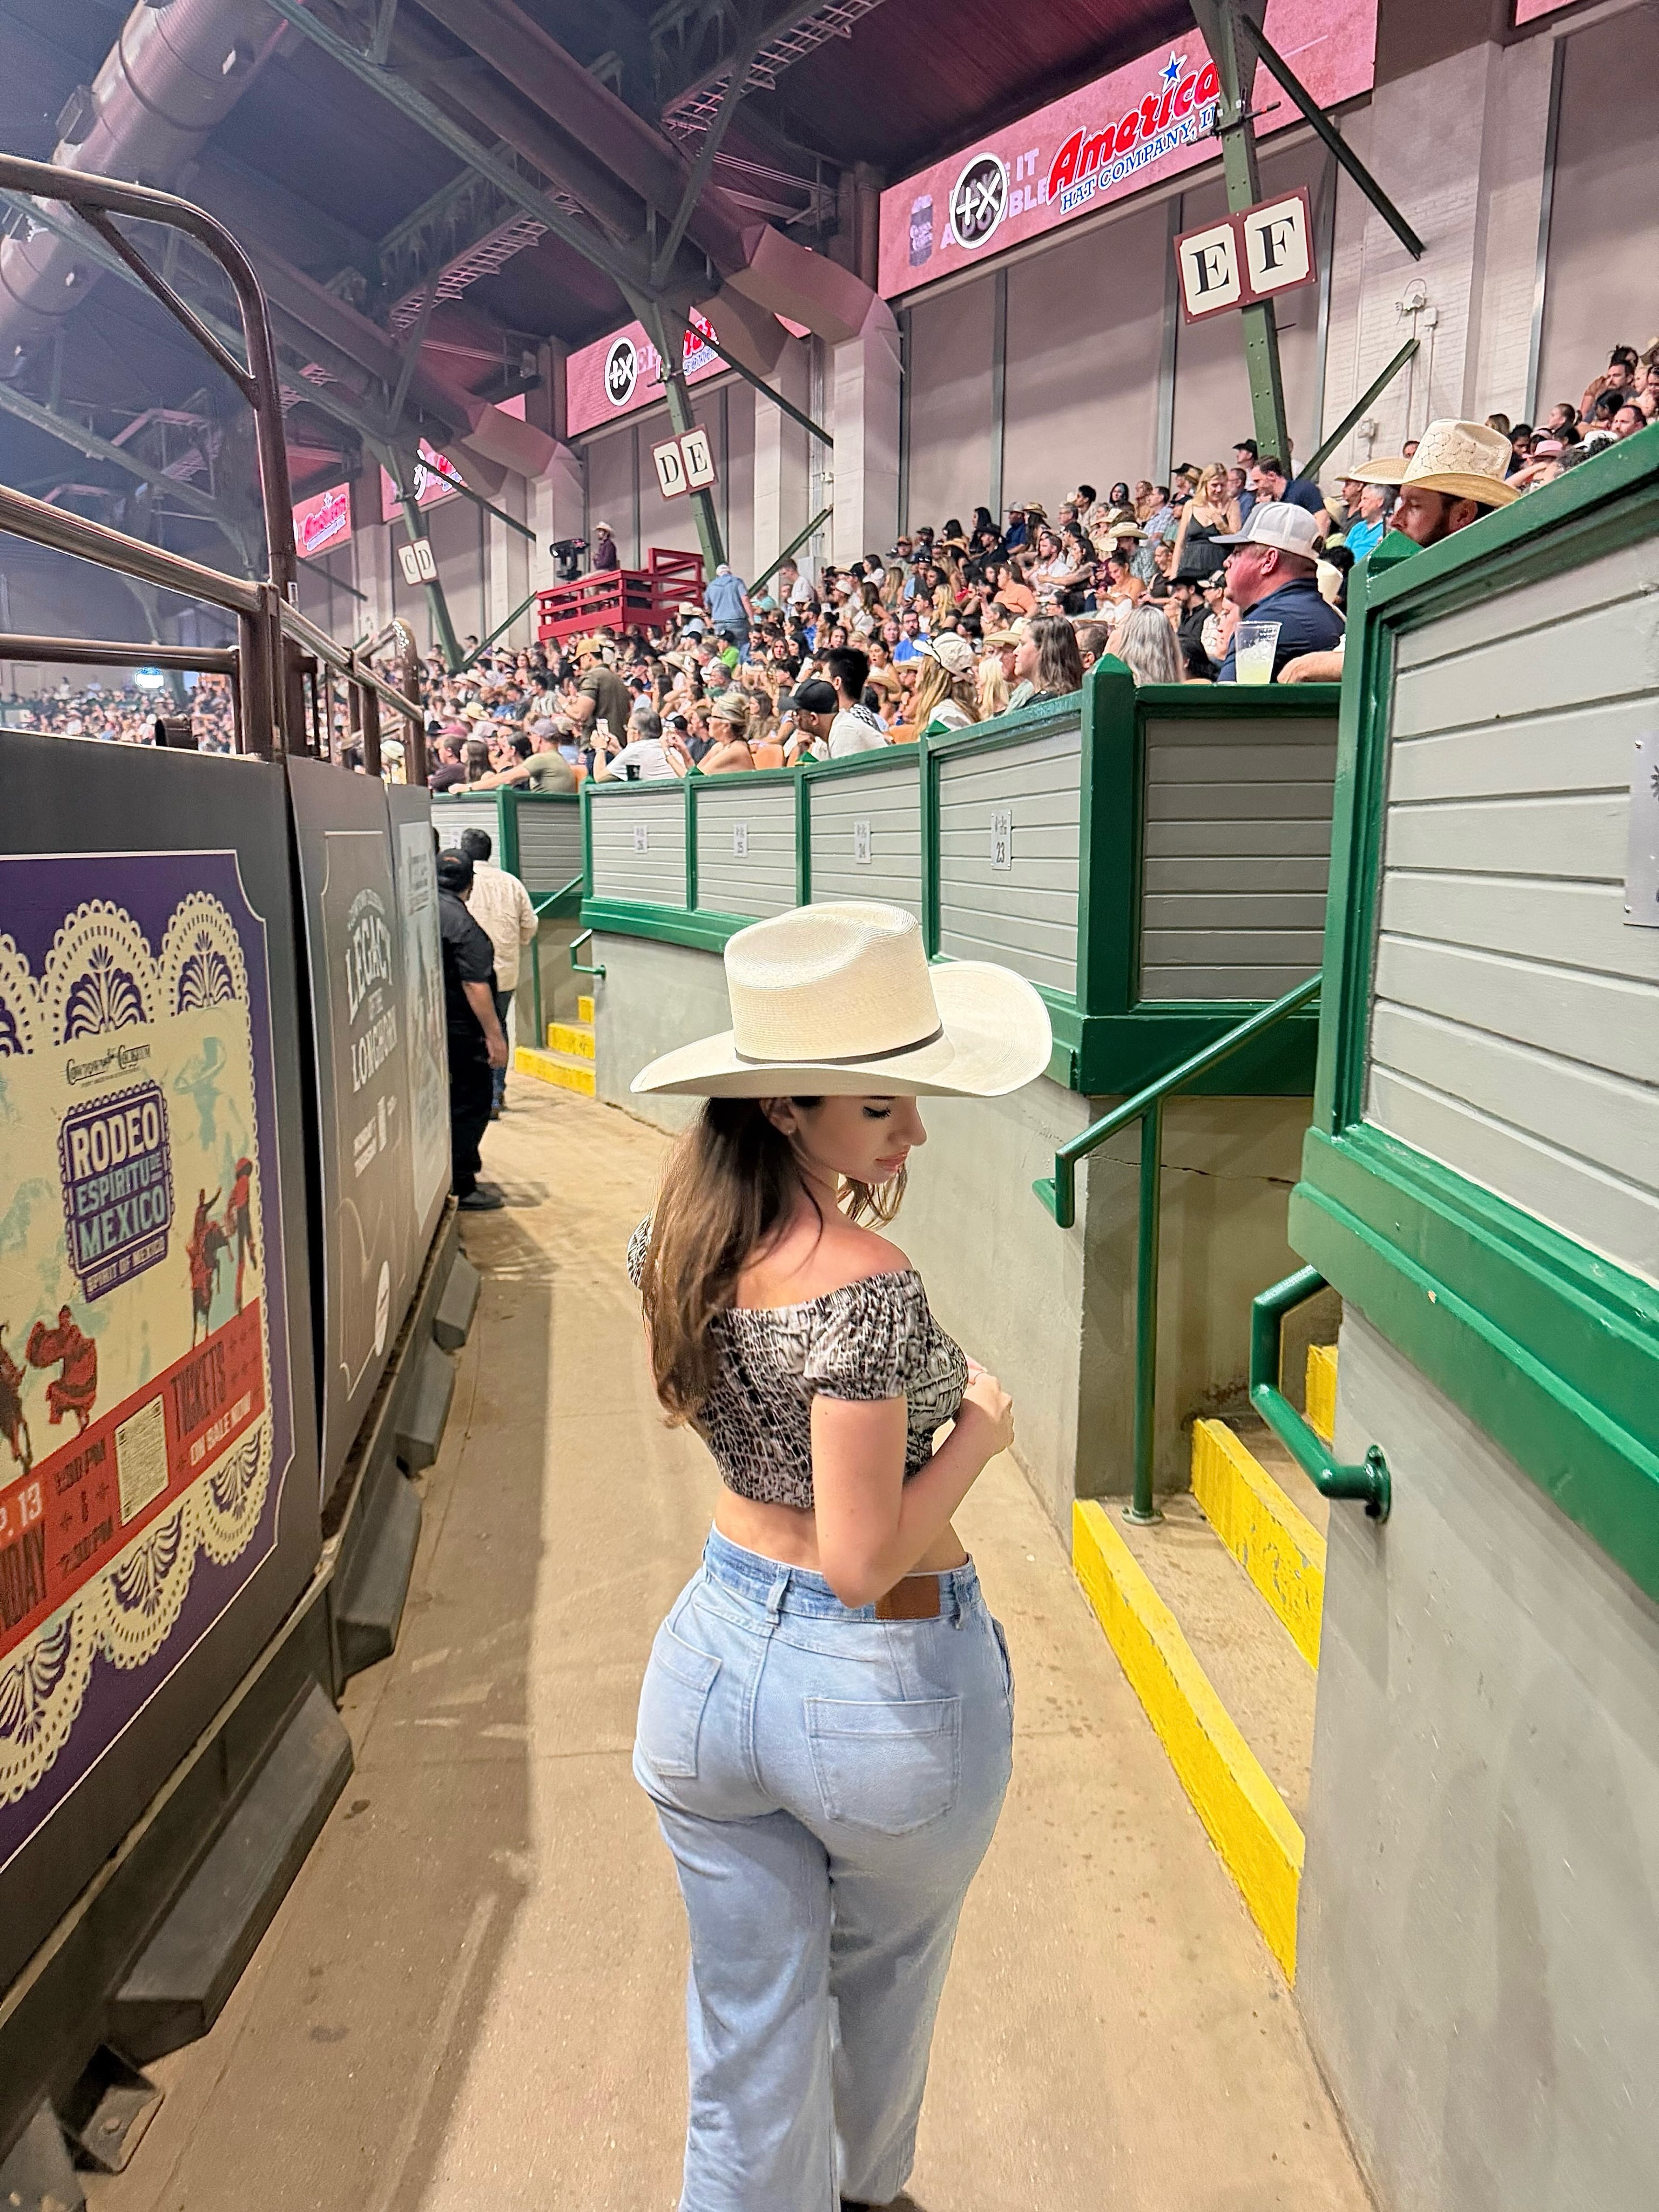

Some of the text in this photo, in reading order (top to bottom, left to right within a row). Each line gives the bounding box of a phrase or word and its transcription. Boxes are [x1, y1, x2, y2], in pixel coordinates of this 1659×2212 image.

[1016, 147, 1040, 181] IT
[1062, 177, 1095, 212] HAT
[1100, 118, 1197, 188] COMPANY,
[1189, 215, 1295, 296] E F
[659, 442, 708, 485] D E
[404, 549, 430, 575] C D
[996, 841, 1005, 864] 23
[345, 915, 393, 1025] LEGACY
[69, 1102, 160, 1182] RODEO
[17, 1482, 43, 1527] 13
